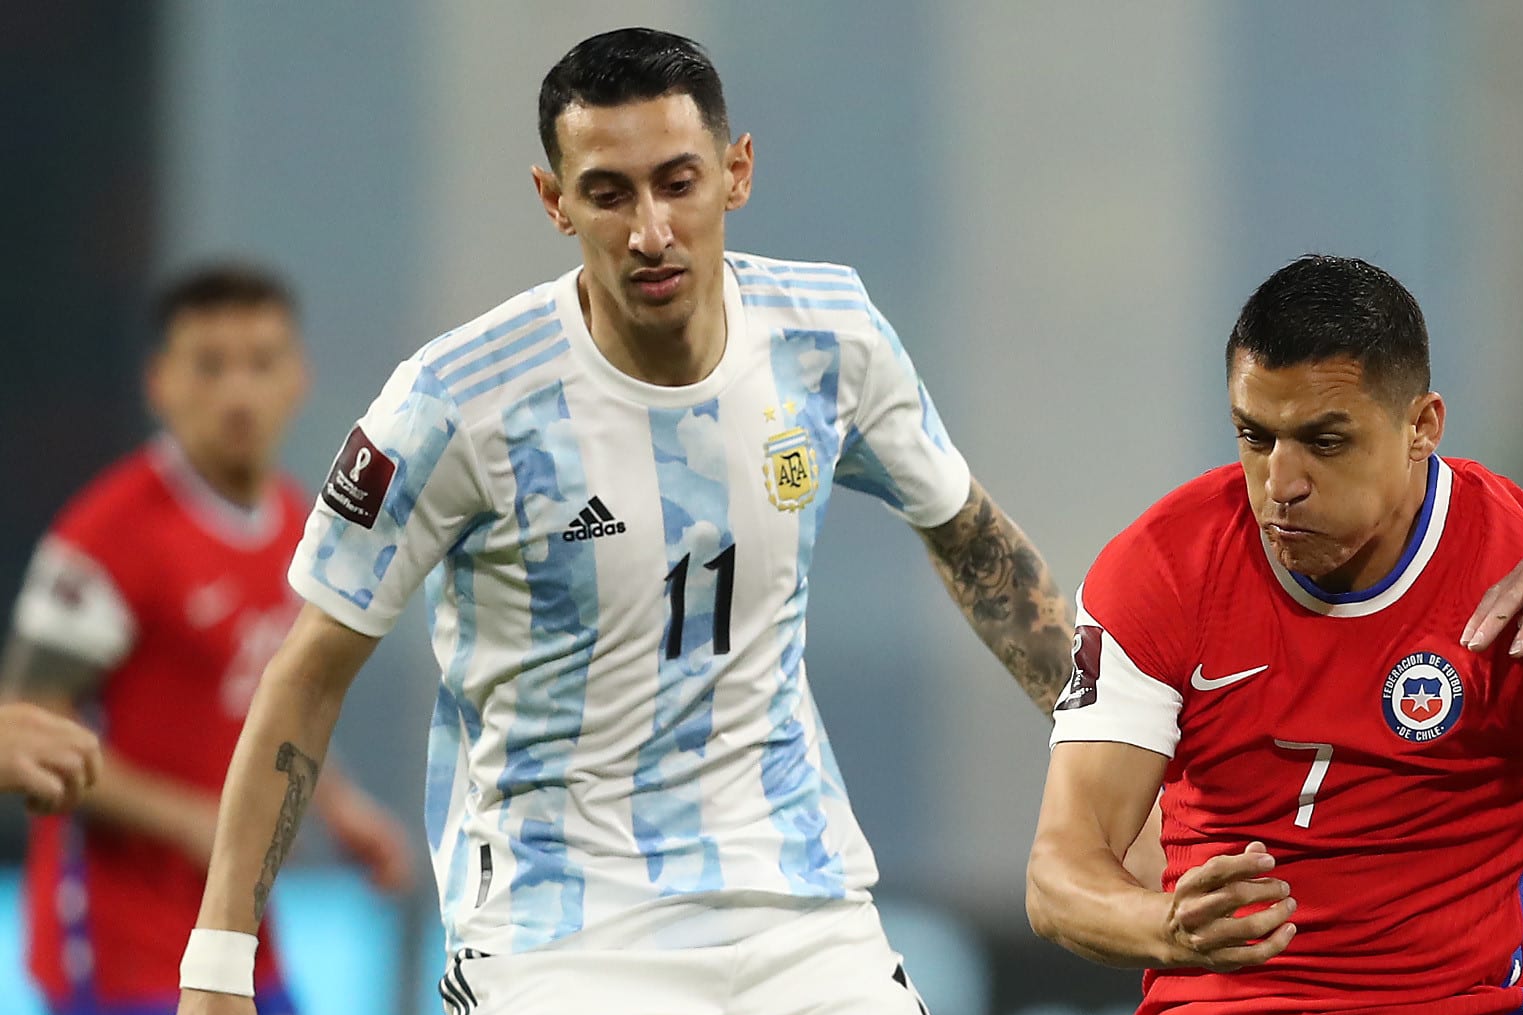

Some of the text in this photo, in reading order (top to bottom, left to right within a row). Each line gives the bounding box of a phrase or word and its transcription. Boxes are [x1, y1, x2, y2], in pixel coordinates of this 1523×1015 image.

[778, 452, 808, 488] AFA
[562, 521, 627, 543] adidas
[664, 543, 736, 661] 11
[1383, 653, 1463, 699] FEDERACION DE FUTBOL
[1398, 726, 1443, 741] DE CHILE
[1274, 739, 1334, 829] 7
